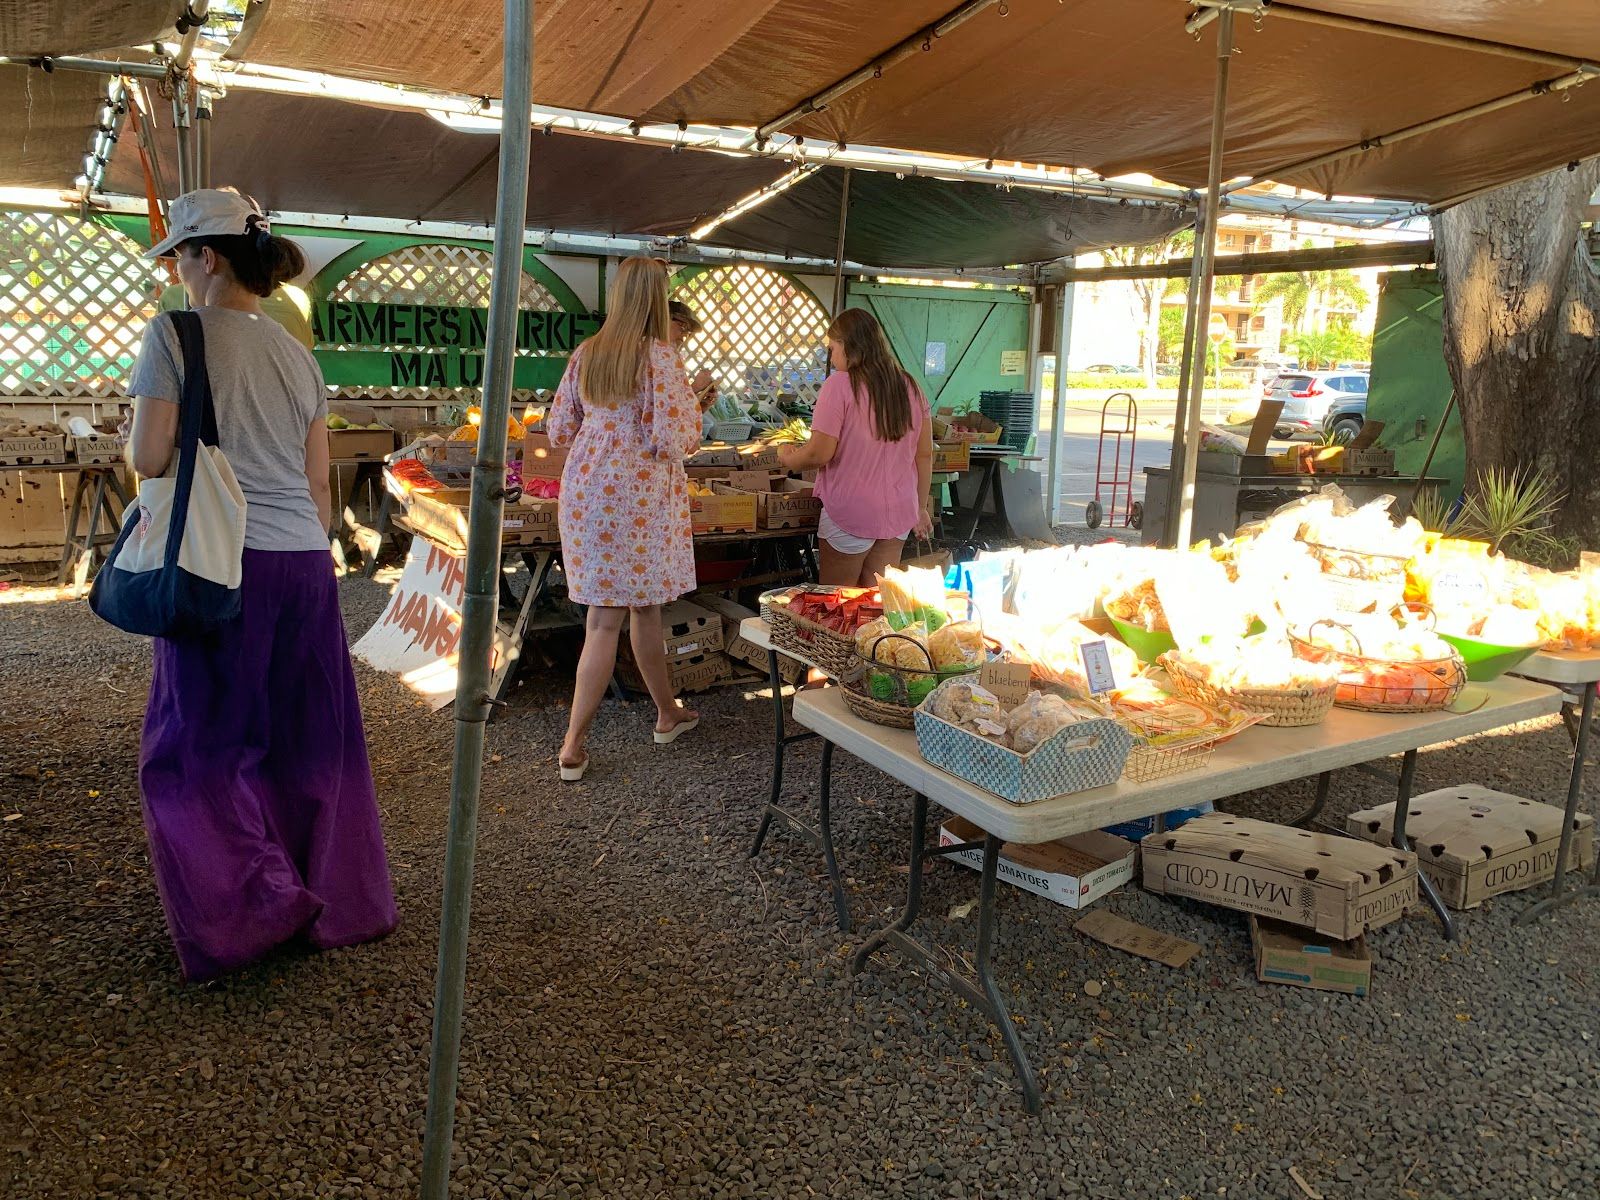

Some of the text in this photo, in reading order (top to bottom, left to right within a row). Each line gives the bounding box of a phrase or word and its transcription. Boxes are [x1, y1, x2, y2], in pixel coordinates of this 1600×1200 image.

[391, 353, 482, 387] MAU
[28, 442, 57, 452] GOLD
[517, 512, 552, 525] GOLD
[779, 499, 810, 511] MAUI
[741, 643, 767, 661] GOLD
[988, 669, 1030, 696] blueberry
[960, 850, 1049, 891] DICE OMATOES
[1485, 859, 1530, 888] GOLD
[1532, 847, 1560, 874] AUI
[1166, 862, 1219, 890] GOLD
[1224, 872, 1293, 907] MAUI
[1354, 886, 1412, 924] MAUI GOLD
